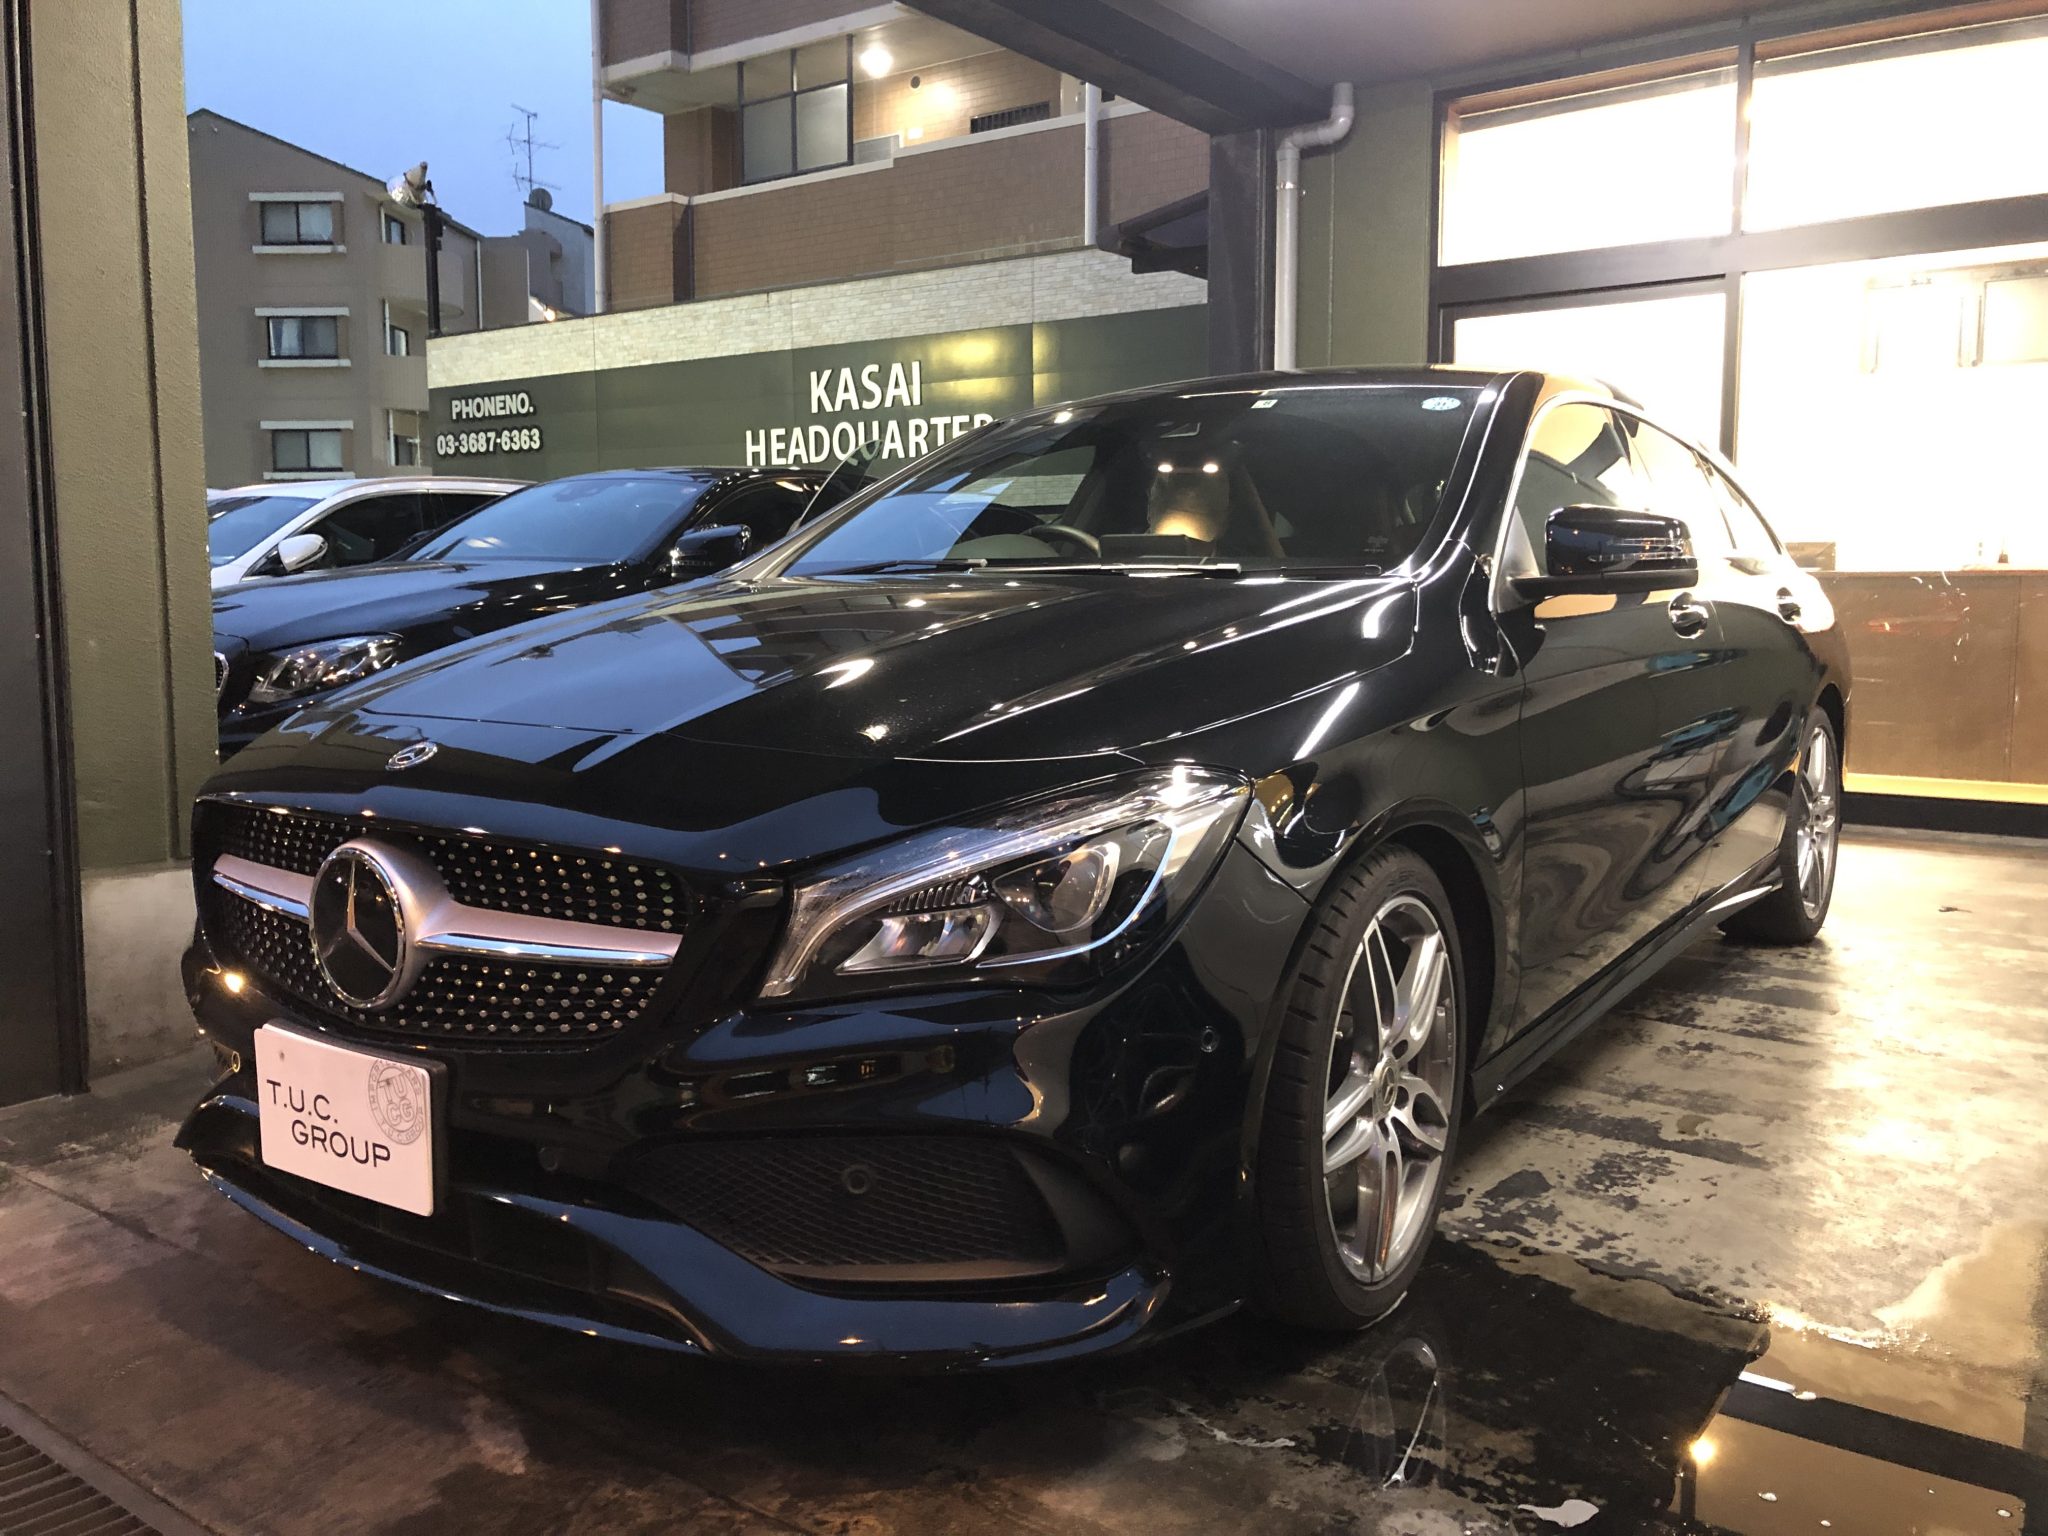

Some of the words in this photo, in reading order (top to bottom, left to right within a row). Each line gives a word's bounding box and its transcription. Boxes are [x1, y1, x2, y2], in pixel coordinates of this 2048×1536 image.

[451, 393, 534, 420] PHONENO.
[810, 361, 922, 414] KASAI
[436, 428, 541, 456] 03-3687-6363
[266, 1079, 338, 1124] T.U.C.
[291, 1119, 391, 1168] GROUP
